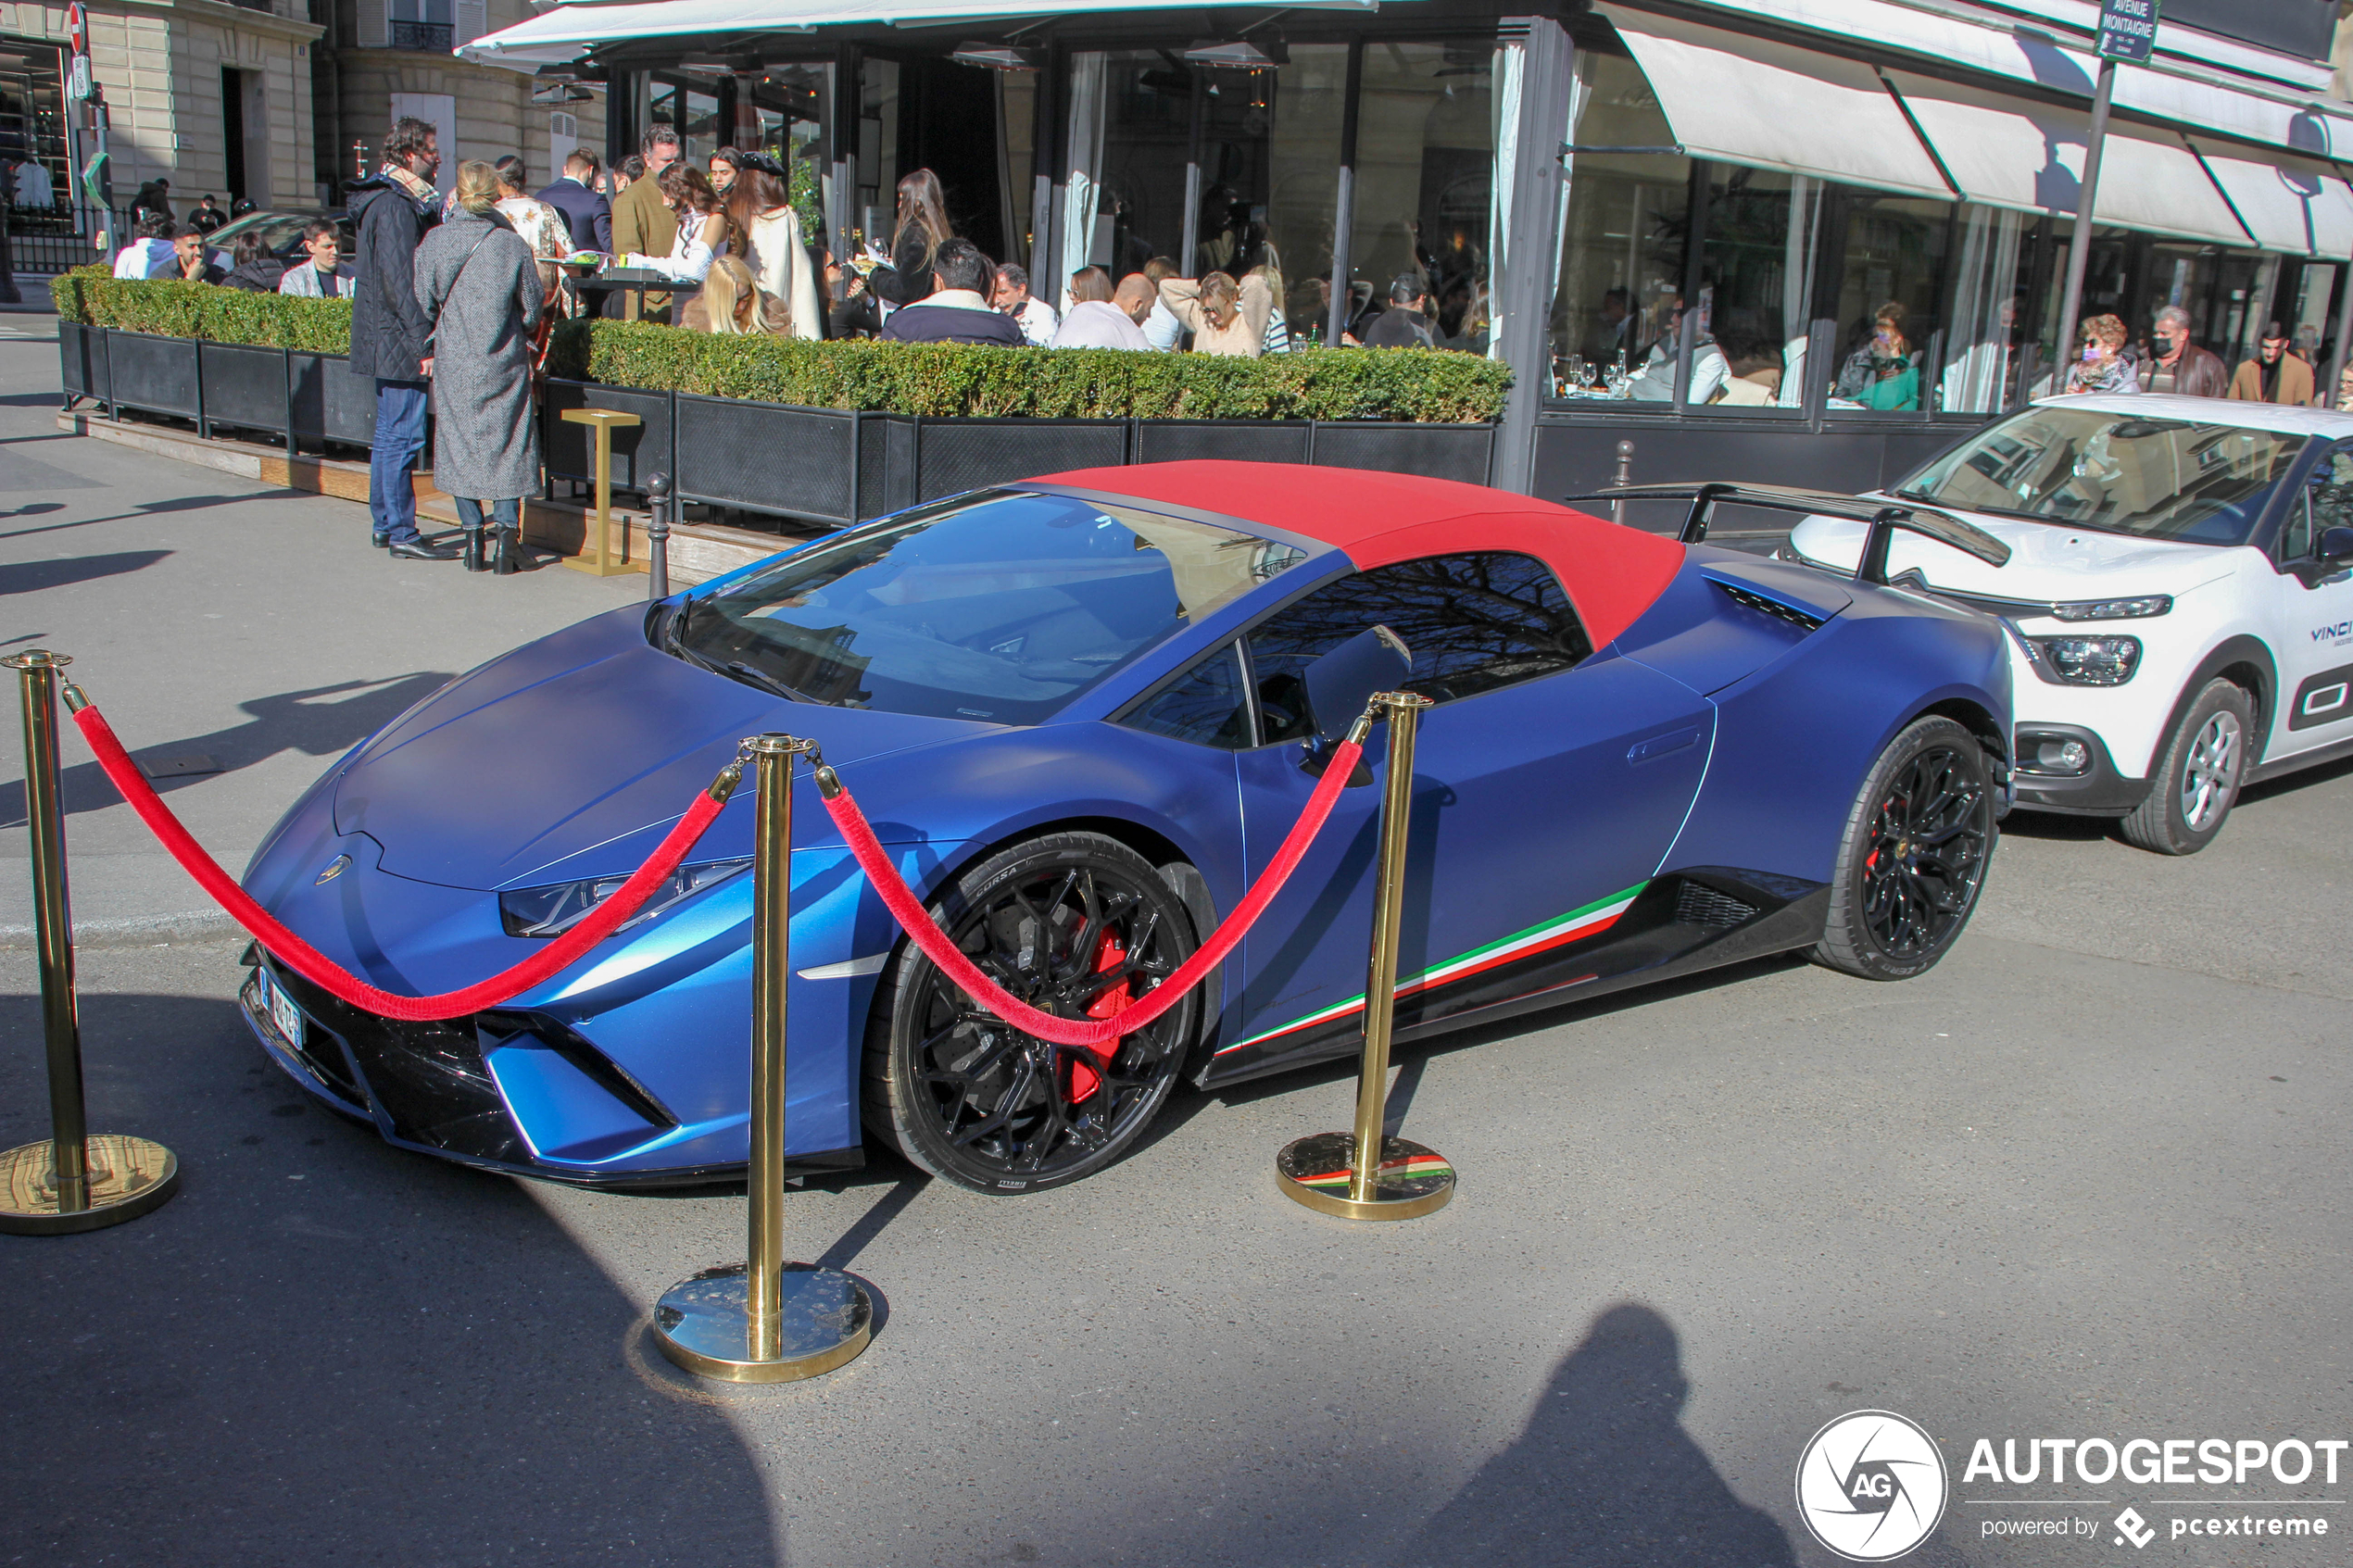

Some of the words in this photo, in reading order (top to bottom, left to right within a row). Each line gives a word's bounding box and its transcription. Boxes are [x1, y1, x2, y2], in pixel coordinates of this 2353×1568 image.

[2114, 0, 2149, 17] AVENUE
[2103, 13, 2154, 38] MONTAIGNE
[2310, 620, 2353, 642] VINCI
[975, 866, 1017, 897] CORSA
[997, 1179, 1027, 1189] PIRELLI
